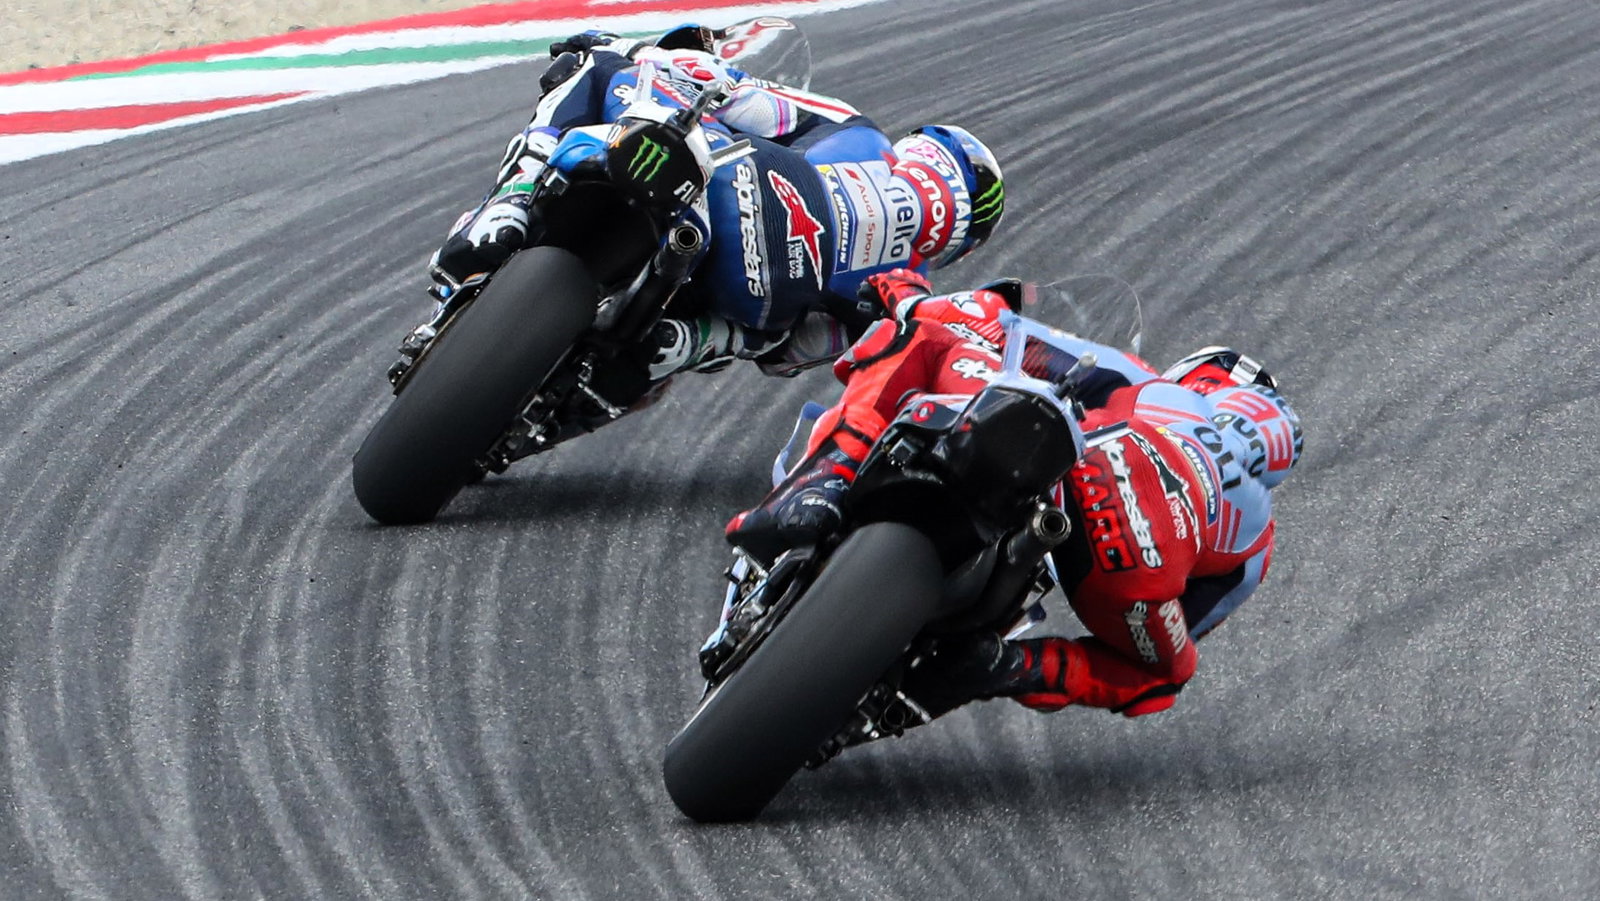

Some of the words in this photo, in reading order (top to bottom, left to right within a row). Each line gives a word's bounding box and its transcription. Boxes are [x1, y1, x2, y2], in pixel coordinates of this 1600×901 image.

[732, 163, 766, 298] alpinestars
[834, 192, 850, 264] MICHELIN
[857, 184, 875, 218] Audi
[884, 186, 916, 258] riello
[892, 160, 946, 254] Lenovo
[861, 222, 877, 265] Sport
[1184, 446, 1217, 515] MICHELIN
